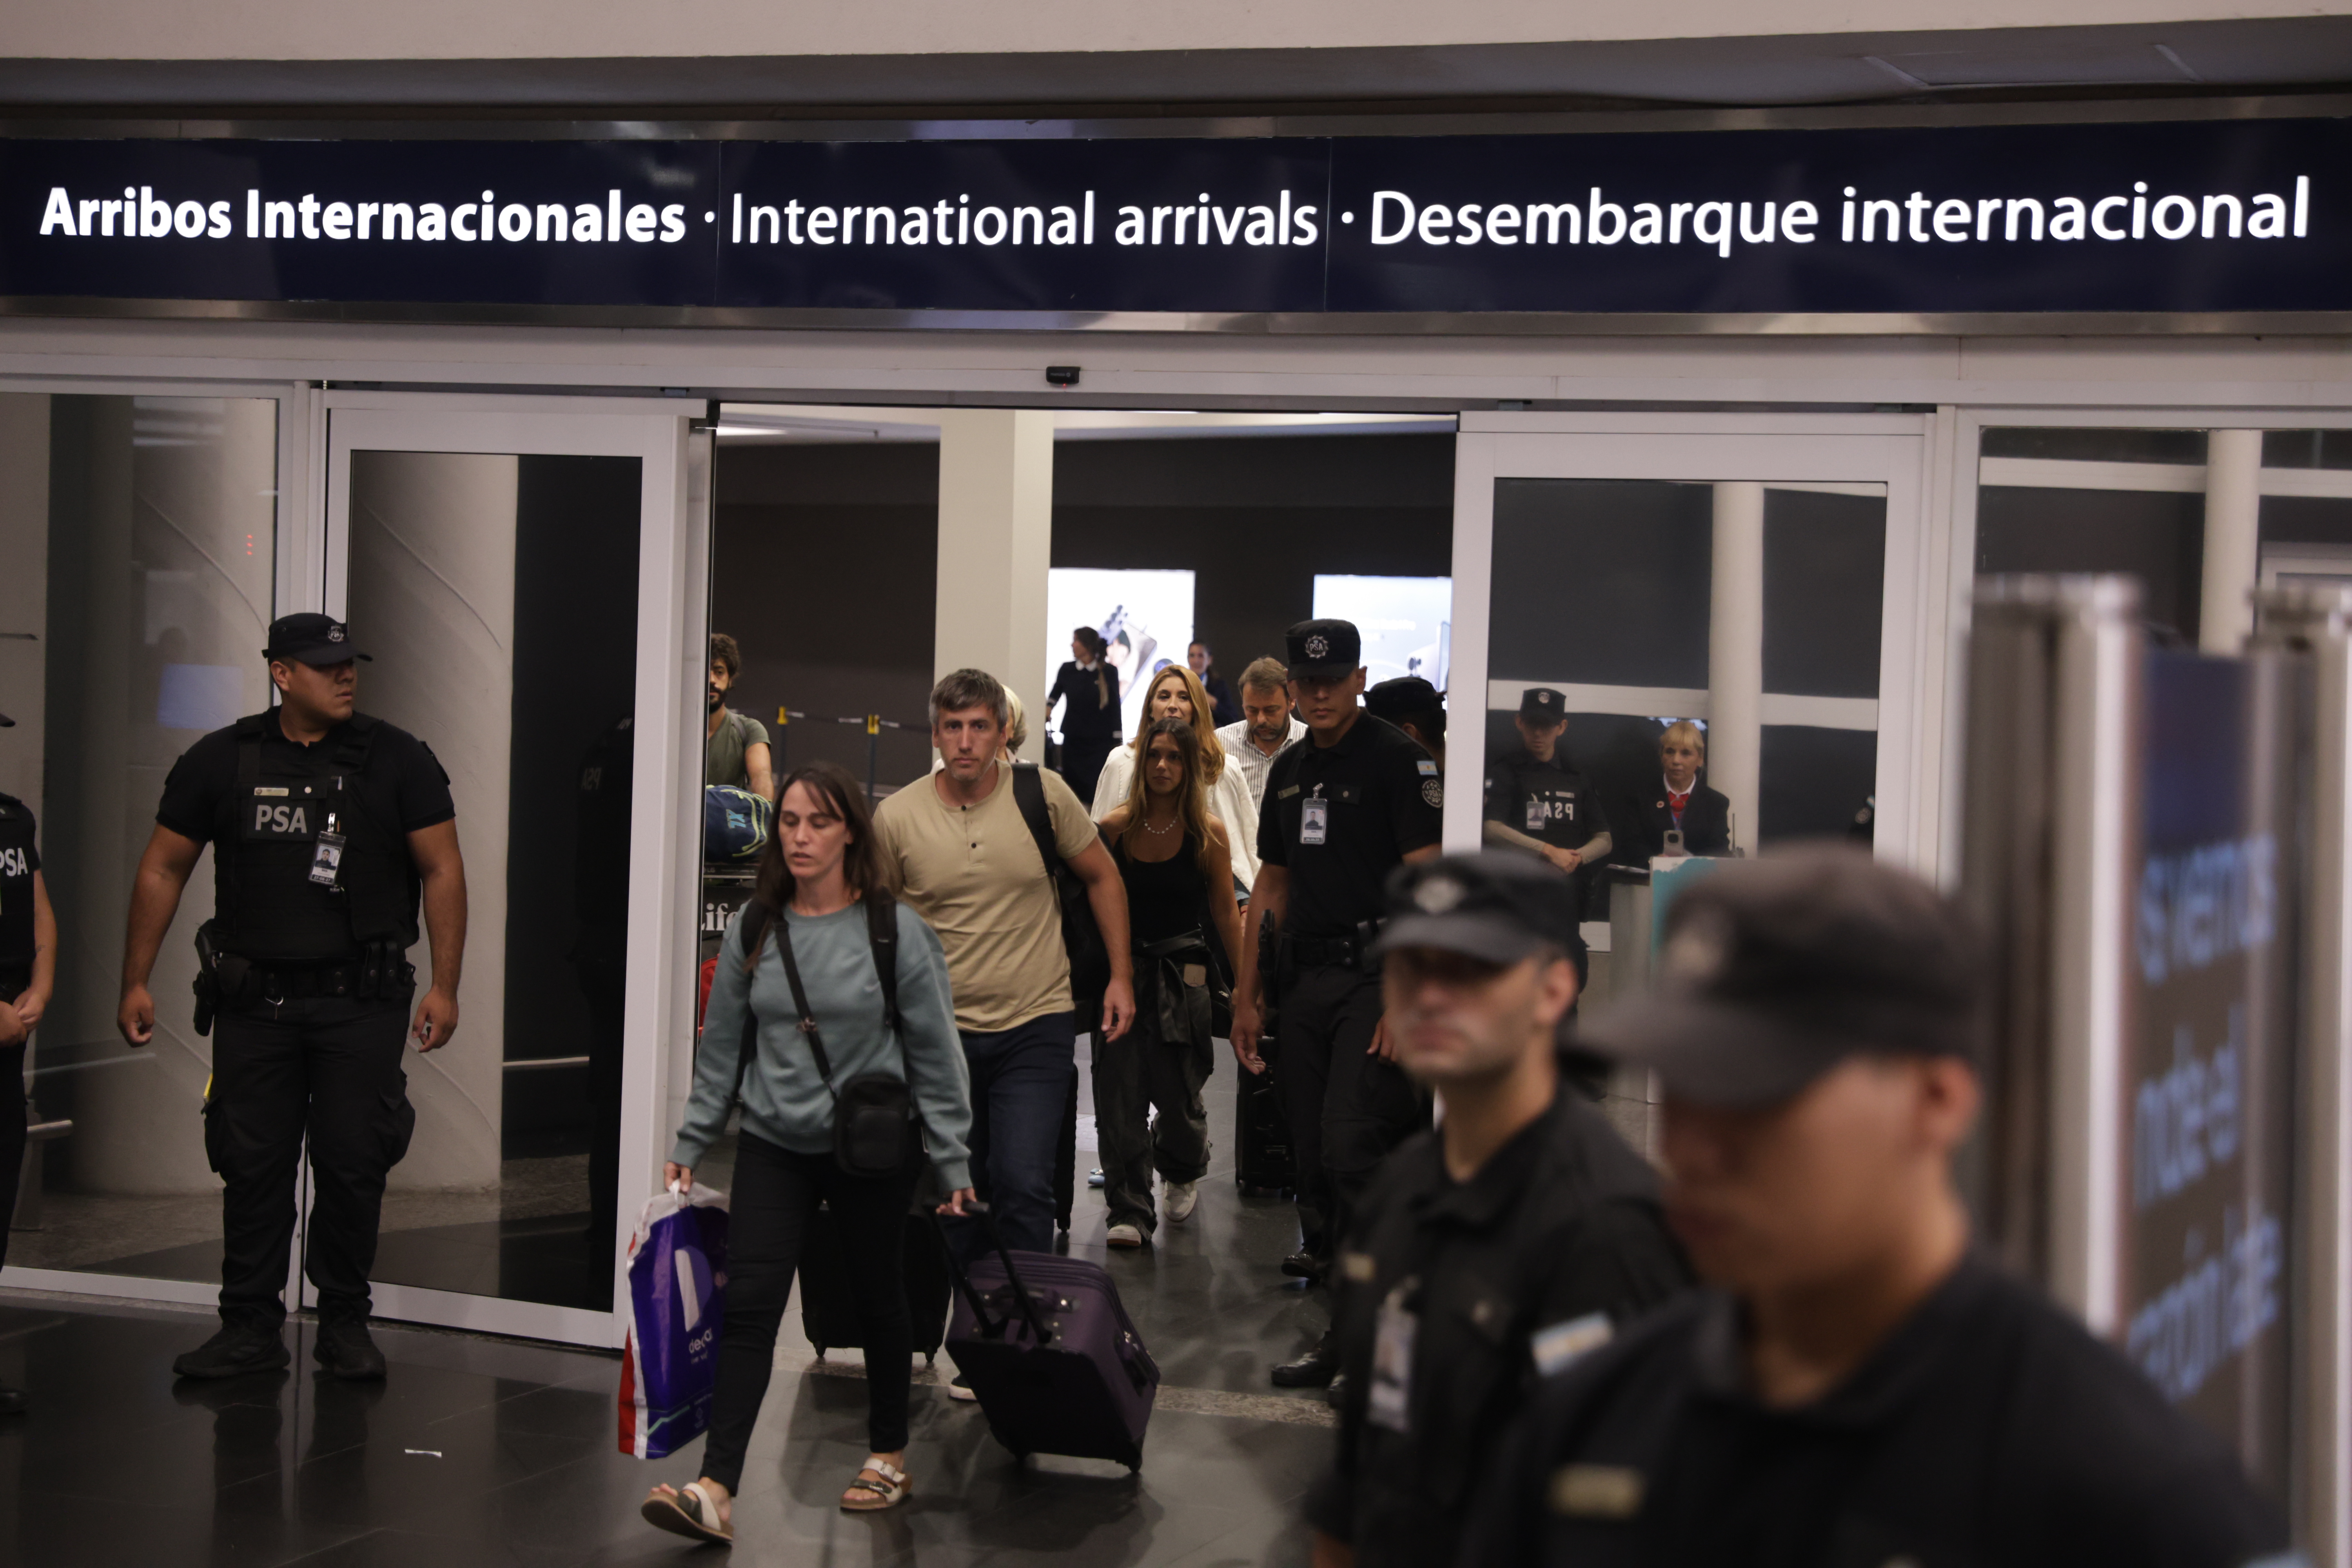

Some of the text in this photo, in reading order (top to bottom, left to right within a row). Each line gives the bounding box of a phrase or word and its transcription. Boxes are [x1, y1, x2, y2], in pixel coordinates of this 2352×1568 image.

[40, 175, 2309, 258] Arribos Internacionales International arrivals Desembarque internacional
[1309, 642, 1323, 652] PSA
[255, 805, 307, 833] PSA
